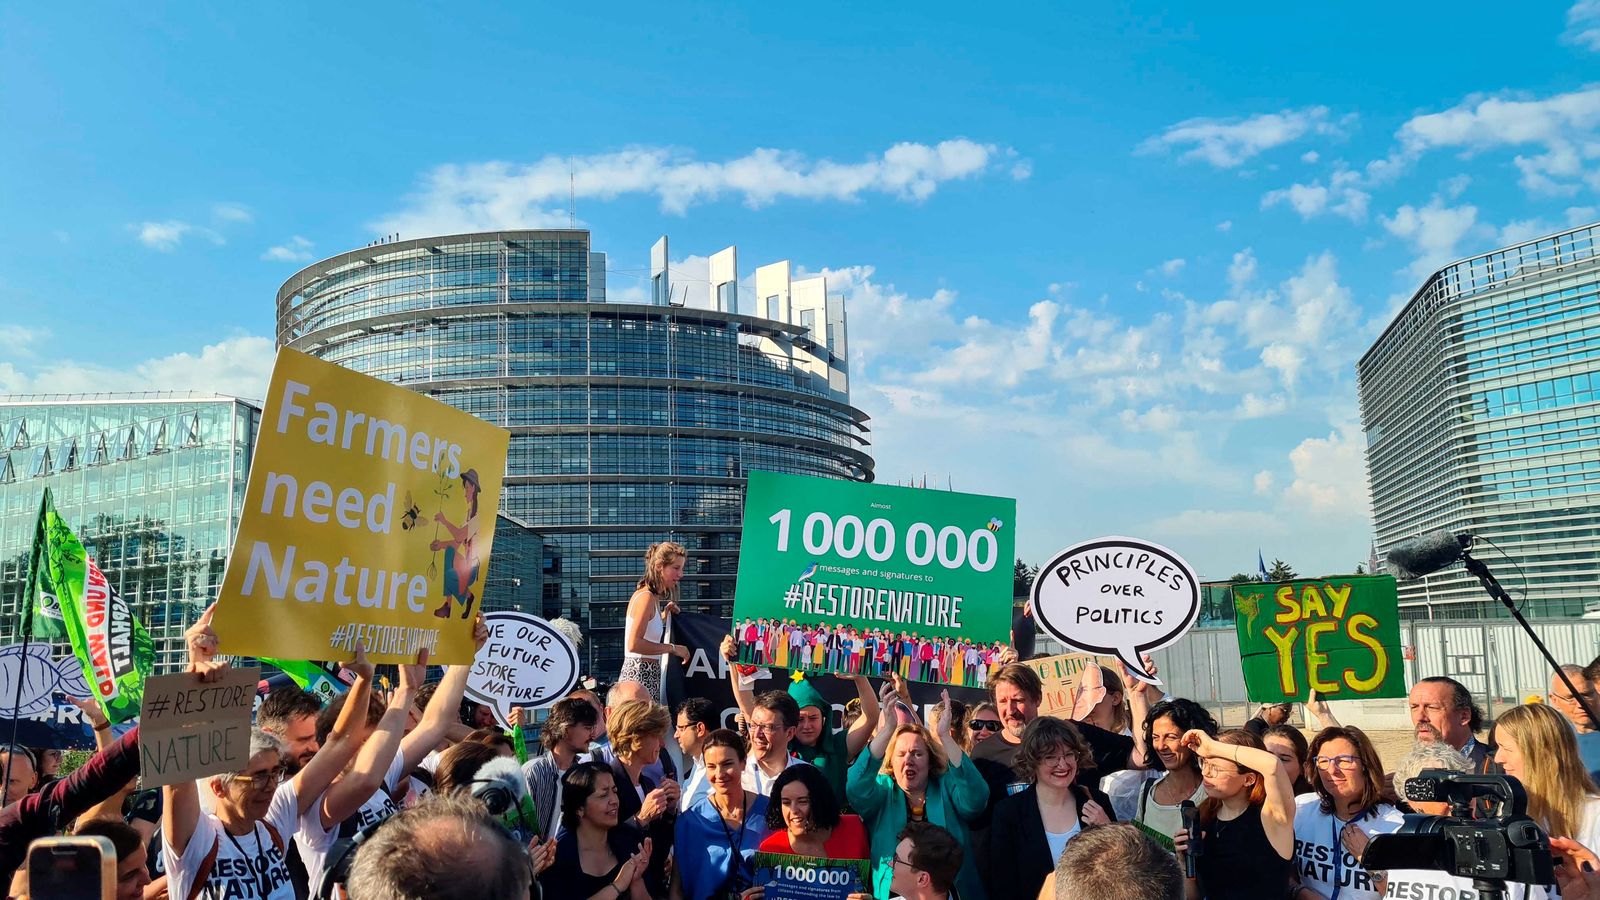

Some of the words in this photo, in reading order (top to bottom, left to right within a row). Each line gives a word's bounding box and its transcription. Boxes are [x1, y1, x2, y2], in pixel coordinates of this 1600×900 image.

[276, 380, 462, 480] Farmers
[260, 471, 395, 535] need
[769, 509, 792, 552] 1
[802, 512, 896, 563] 000
[905, 522, 998, 572] 000
[240, 541, 428, 613] Nature
[819, 564, 860, 575] messages
[862, 569, 877, 577] and
[880, 570, 923, 581] signatures
[1056, 552, 1184, 591] PRINCIPLES
[783, 581, 963, 628] #RESTORENATURE
[1100, 583, 1144, 597] OVER
[1274, 583, 1352, 624] SAY
[1076, 606, 1163, 625] POLITICS
[330, 623, 440, 656] #RESTORENATURE
[488, 624, 505, 638] VE
[516, 626, 552, 651] OUR
[487, 643, 555, 673] FUTURE
[1263, 614, 1390, 696] YES
[474, 661, 517, 684] STORE
[481, 679, 546, 700] NATURE
[147, 684, 253, 719] #RESTORE
[142, 726, 238, 778] NATURE
[774, 864, 782, 879] 1
[785, 866, 816, 883] 000
[819, 870, 850, 886] 000
[1387, 881, 1476, 900] RESTOR
